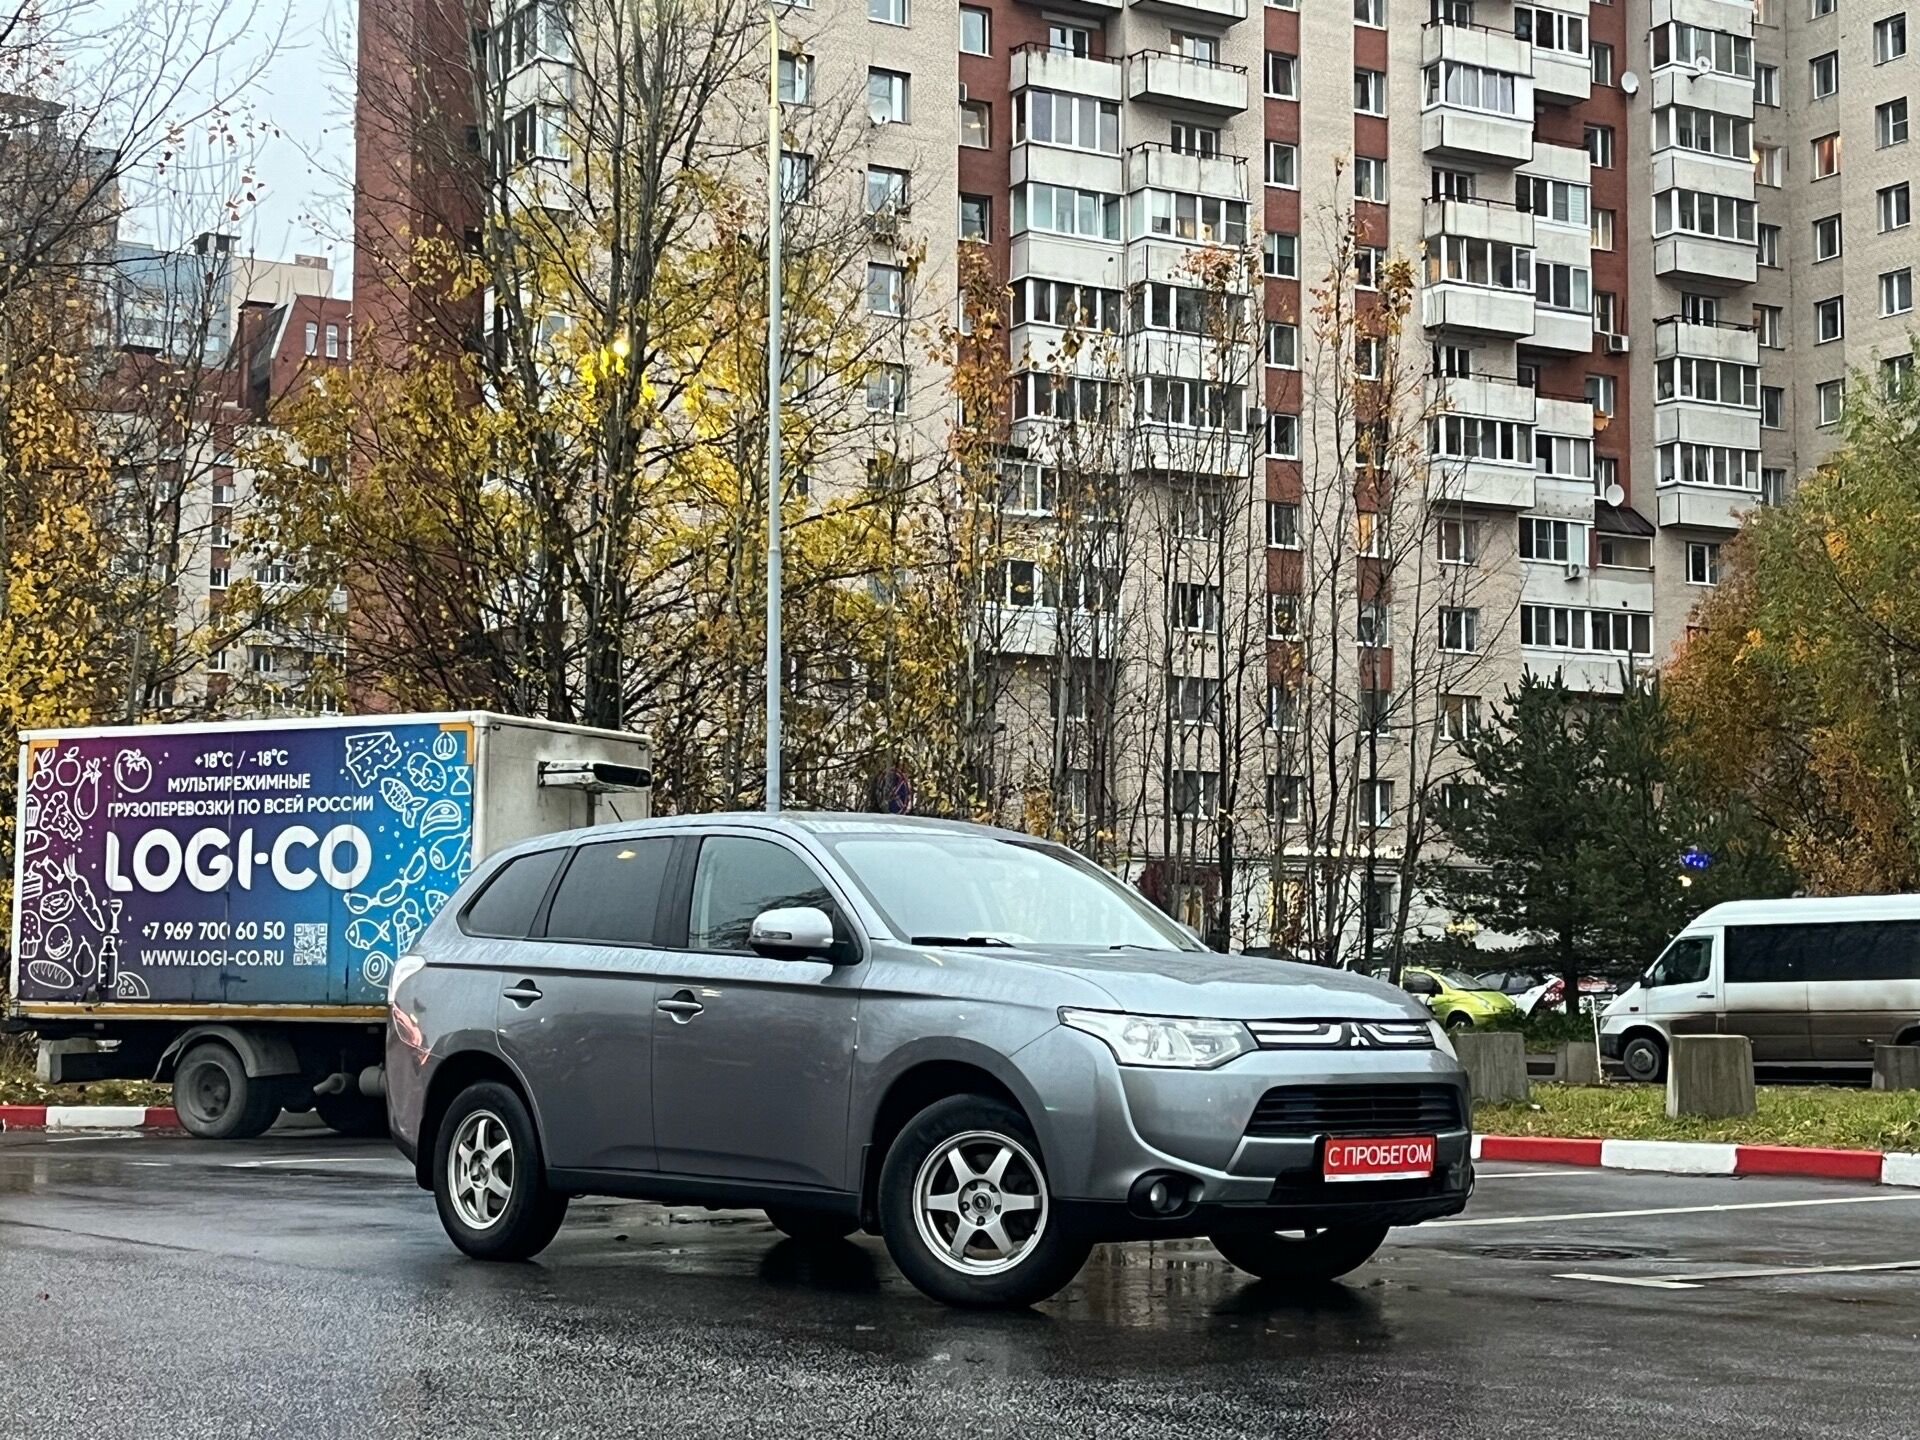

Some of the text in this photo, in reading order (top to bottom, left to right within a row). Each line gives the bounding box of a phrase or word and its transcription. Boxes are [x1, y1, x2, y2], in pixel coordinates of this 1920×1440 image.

[237, 750, 246, 769] /
[168, 773, 311, 793] МУЛЬТИРЕЖИМНЫЕ
[107, 794, 374, 818] ГРУЗОПЕРЕВОЗКИ ПО ВСЕЙ РОССИИ
[105, 824, 372, 893] LOGI-CO
[142, 921, 286, 941] +7 969 700 60 50
[140, 949, 285, 967] WWW.LOGI-CO.RU
[1328, 1144, 1432, 1167] С ПРОБЕГОМ
